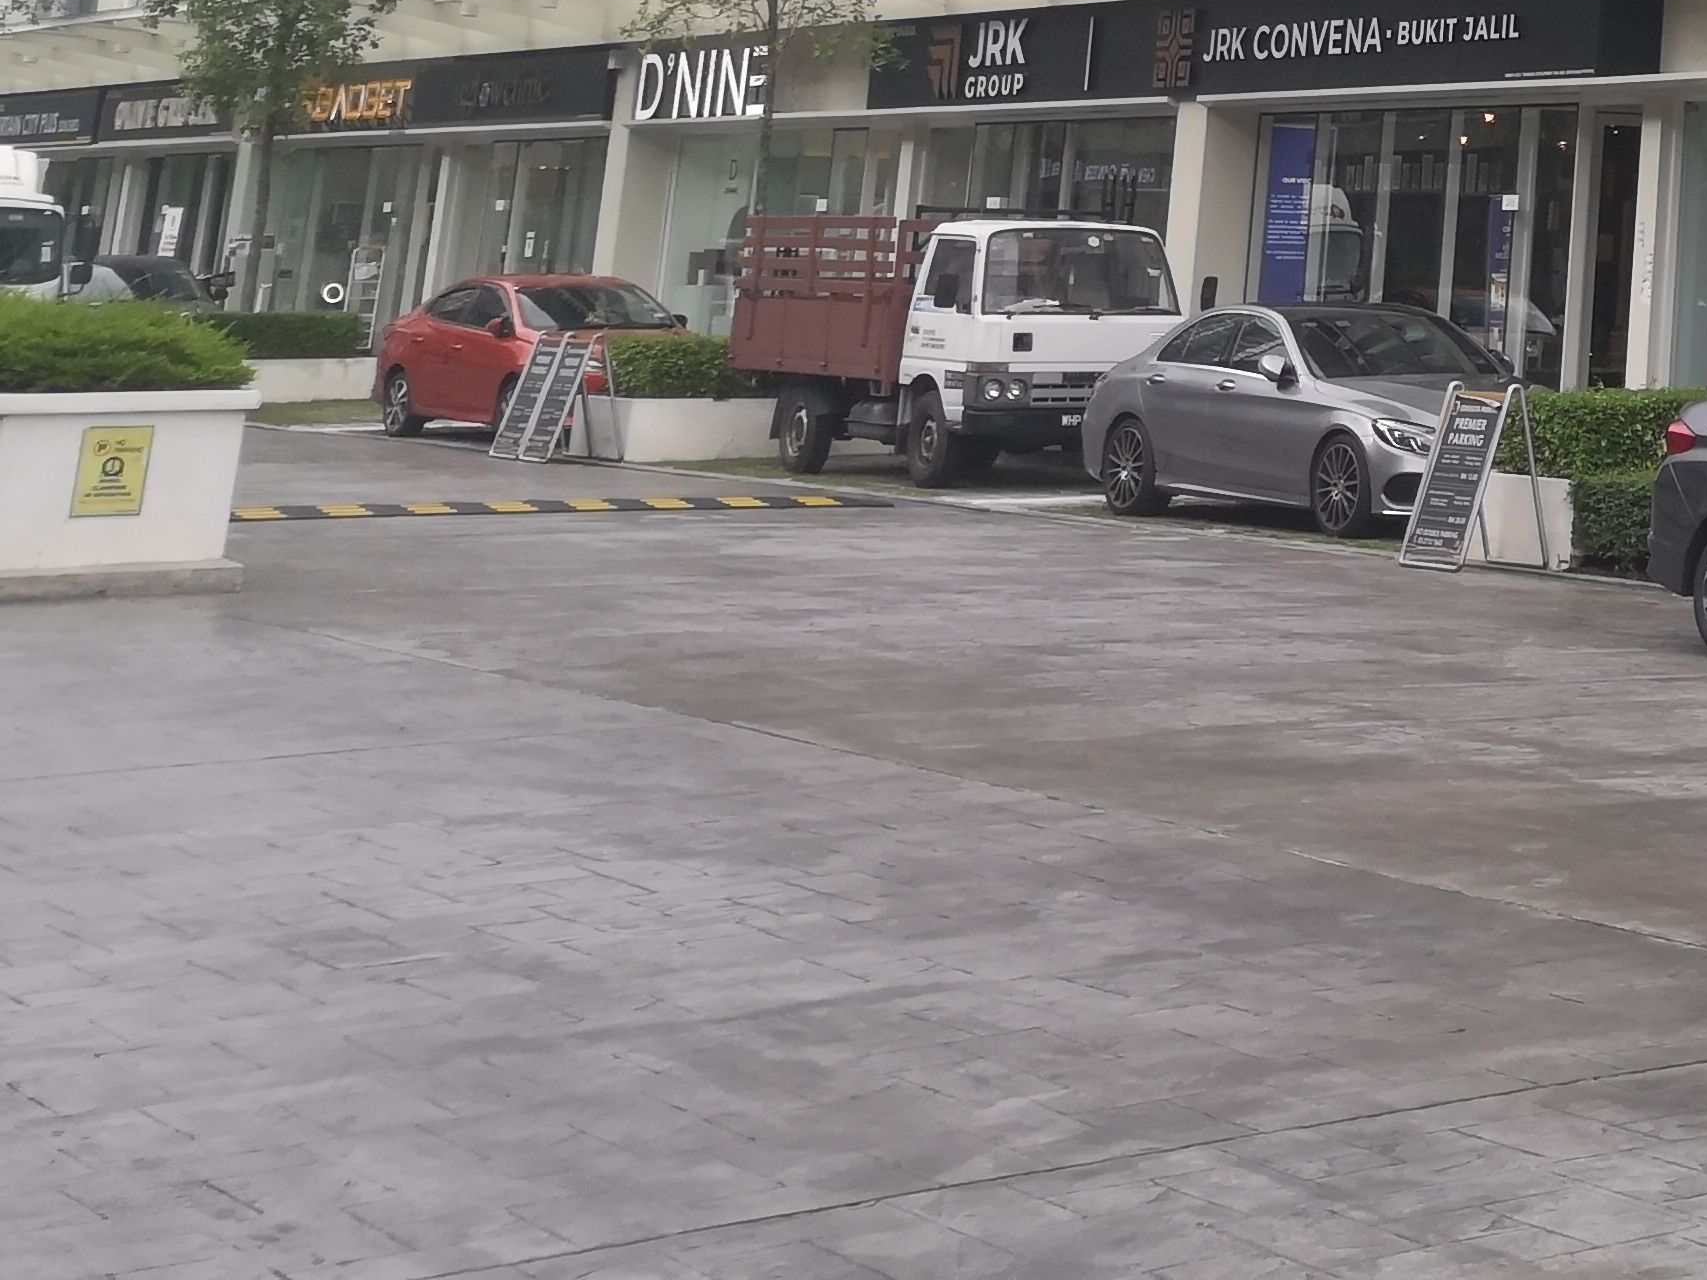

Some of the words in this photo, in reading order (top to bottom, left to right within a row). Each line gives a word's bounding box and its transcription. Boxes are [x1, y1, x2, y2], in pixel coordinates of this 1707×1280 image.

[968, 18, 1029, 68] JRK
[1203, 27, 1247, 62] JRK
[1253, 17, 1382, 60] CONVENA
[1397, 18, 1457, 45] BUKIT
[1463, 14, 1520, 42] JALIL
[964, 73, 1024, 99] GROUP
[1453, 417, 1487, 431] PREMIER
[1448, 433, 1484, 447] PARKING
